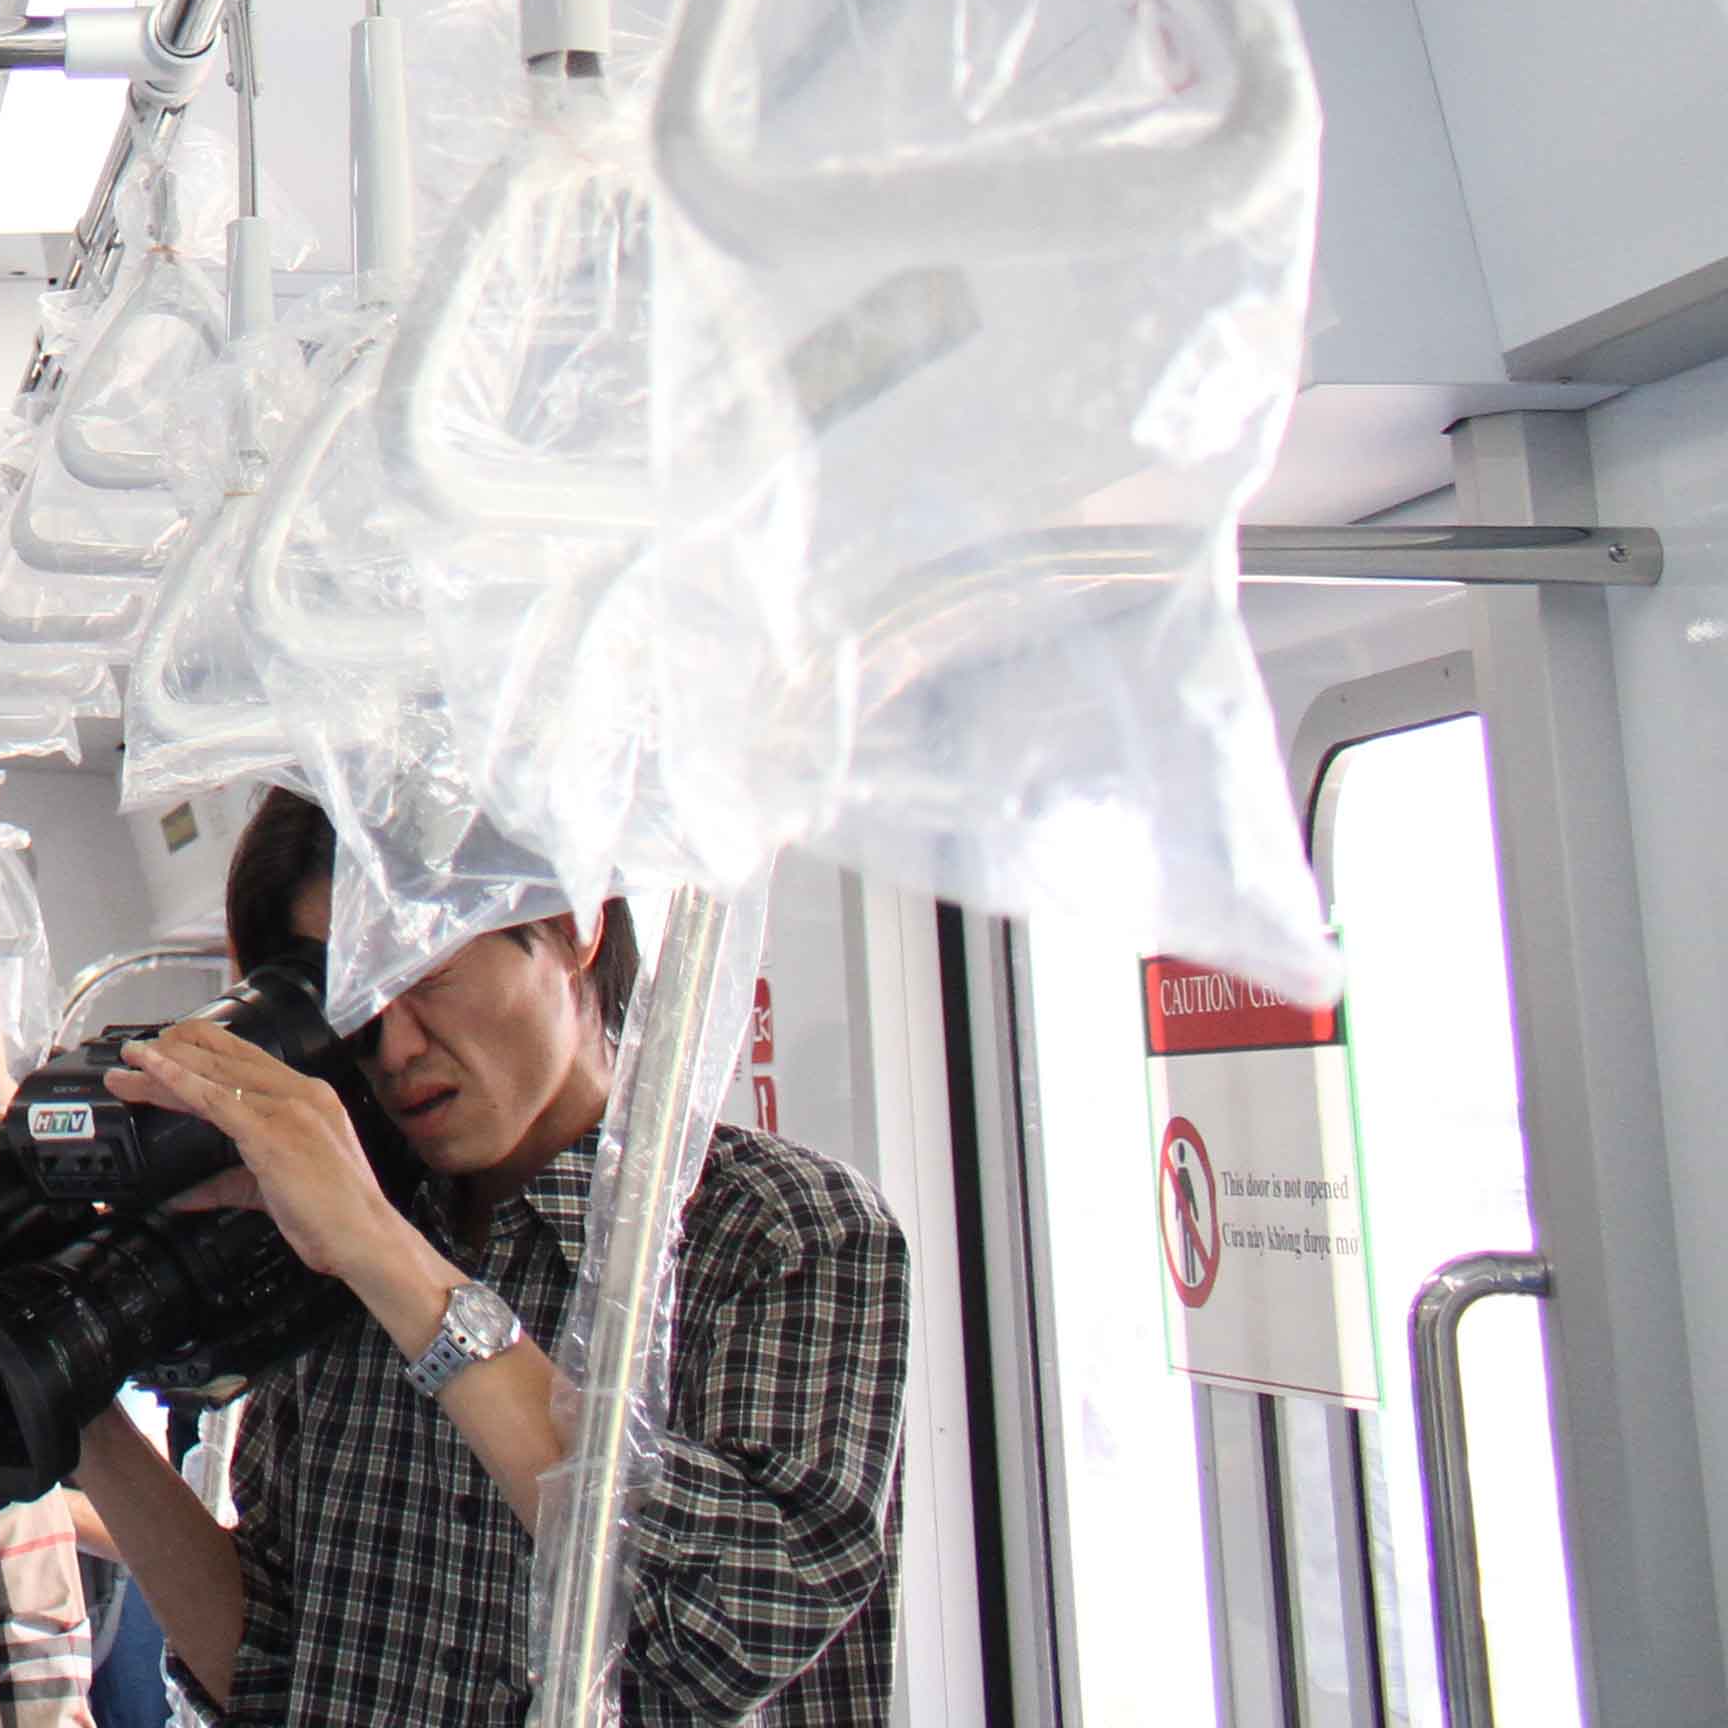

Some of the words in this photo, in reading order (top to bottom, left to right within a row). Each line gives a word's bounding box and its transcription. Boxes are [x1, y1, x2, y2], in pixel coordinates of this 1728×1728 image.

[1160, 973, 1236, 1016] CAUTION
[32, 1109, 88, 1134] HTV
[1220, 1170, 1244, 1197] This
[1246, 1172, 1271, 1198] door
[1271, 1173, 1282, 1198] is
[1284, 1177, 1302, 1199] not
[1304, 1175, 1349, 1207] opened
